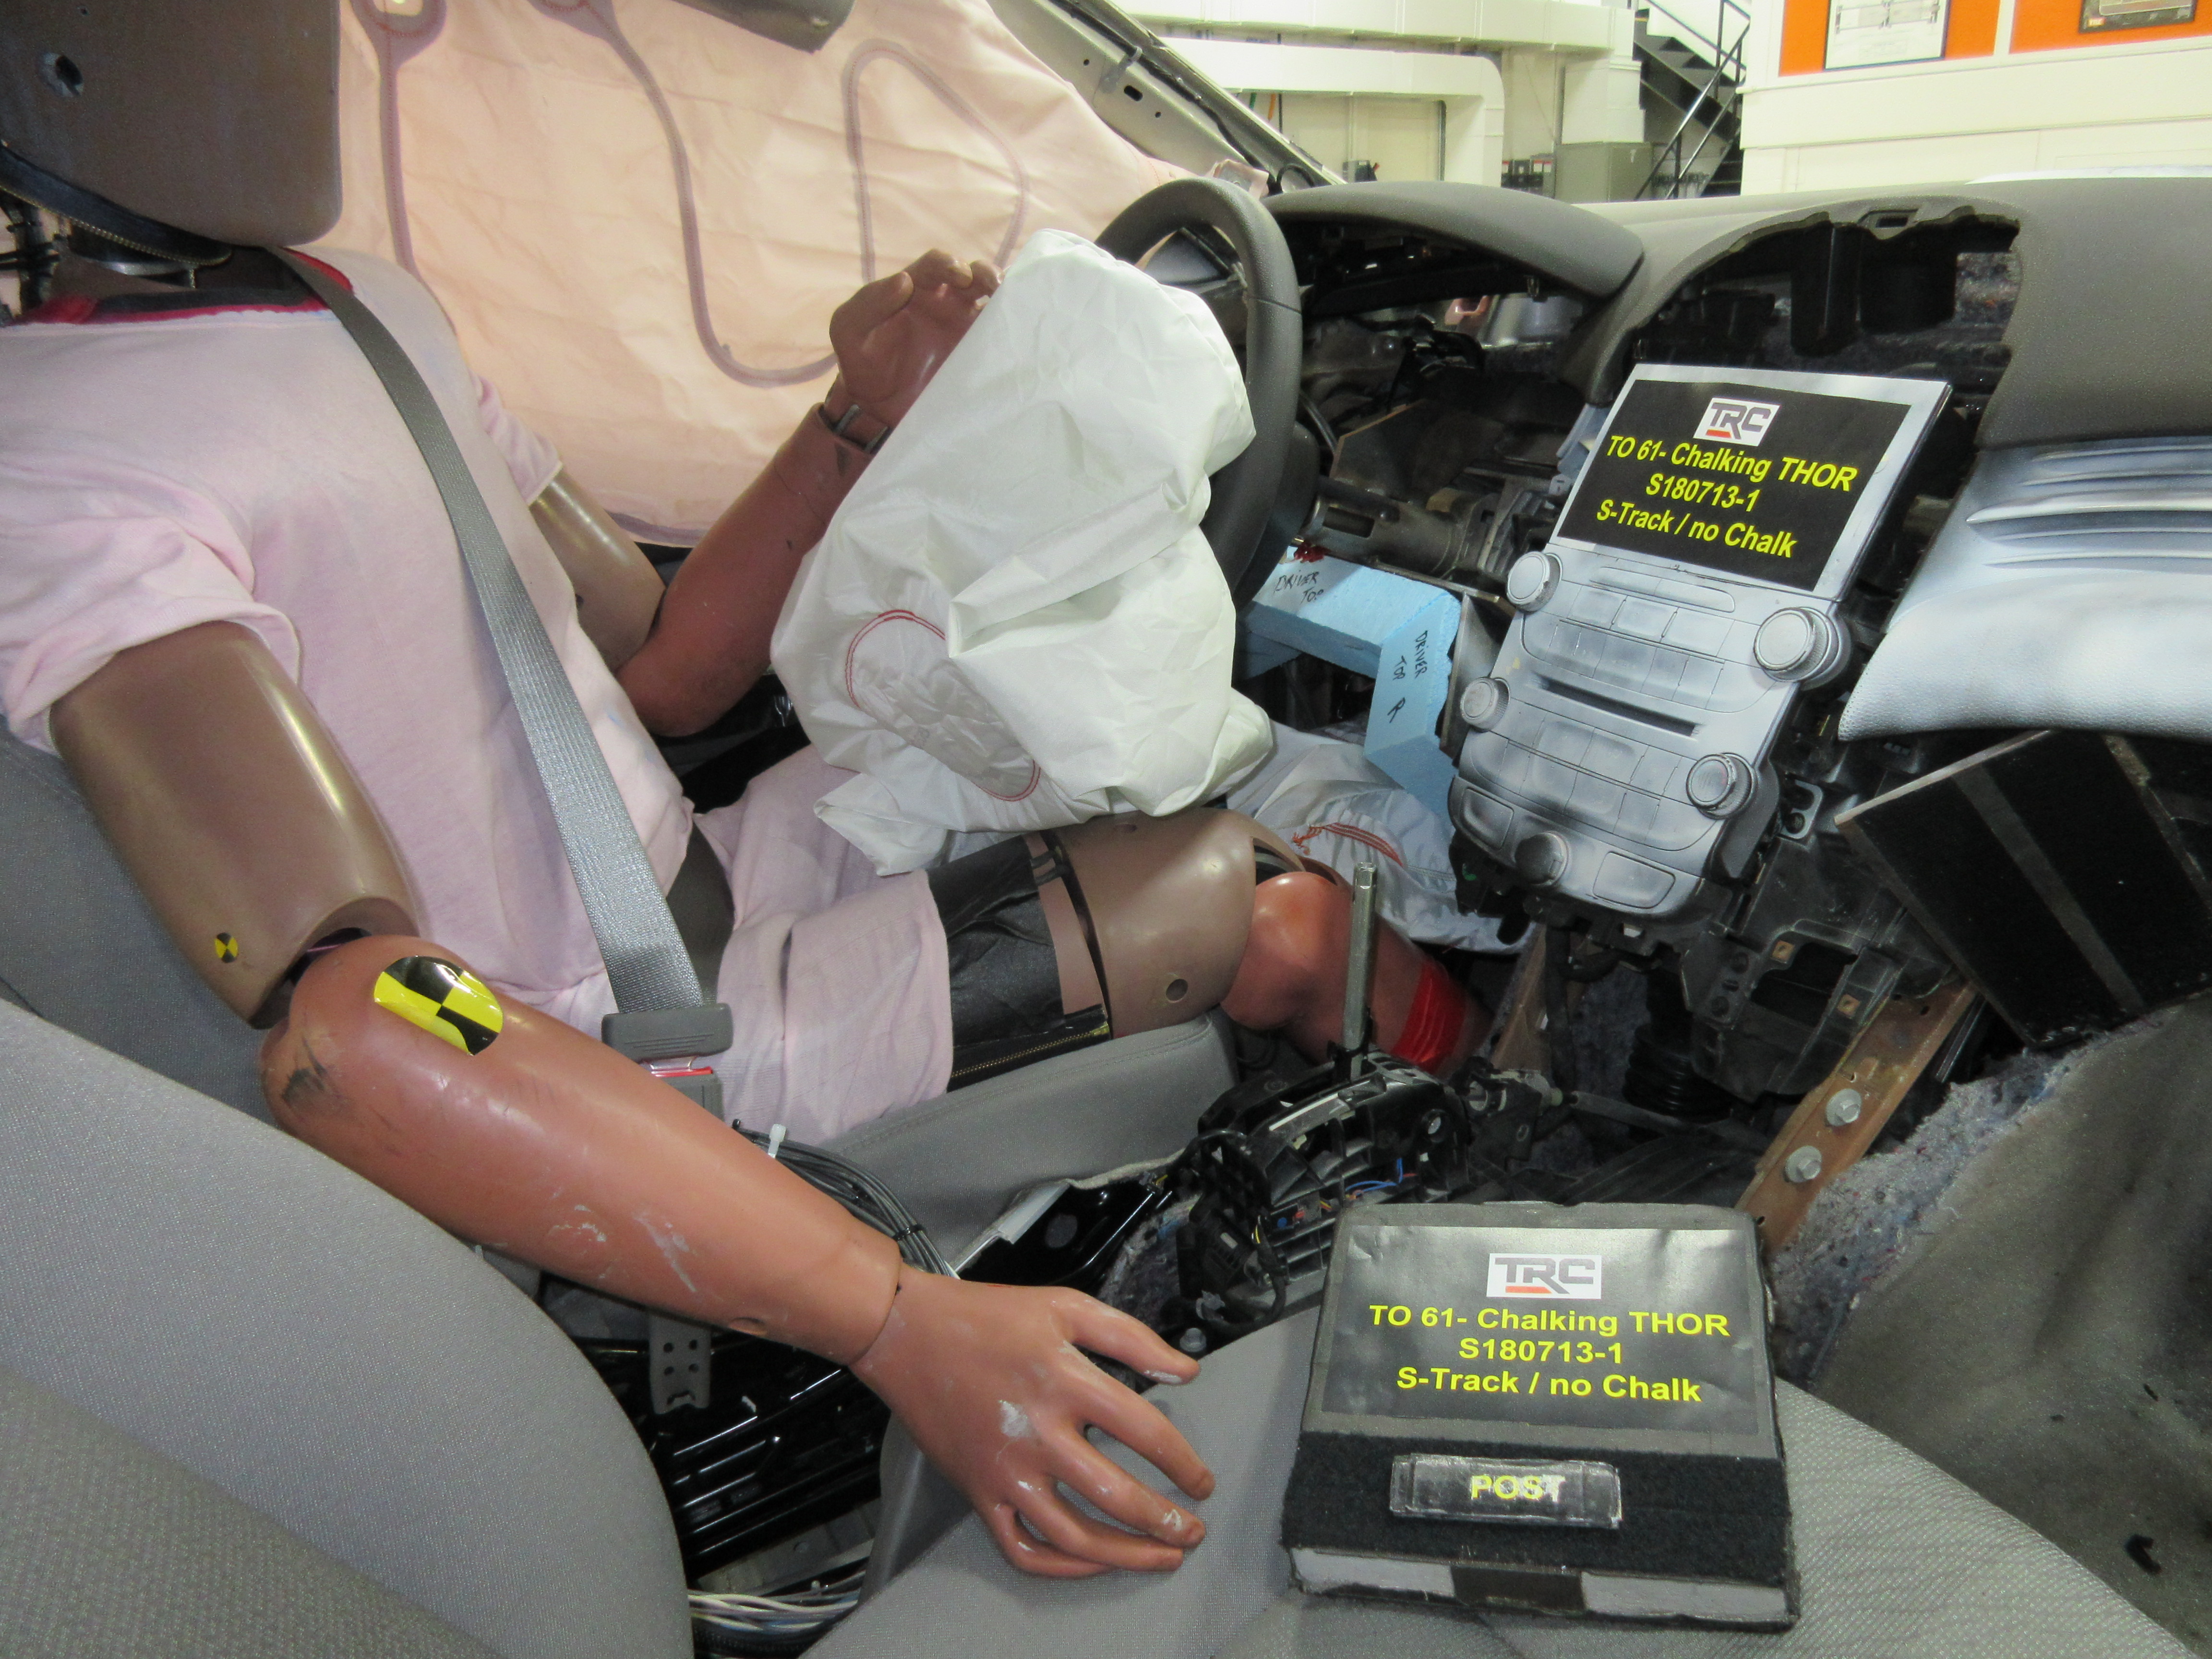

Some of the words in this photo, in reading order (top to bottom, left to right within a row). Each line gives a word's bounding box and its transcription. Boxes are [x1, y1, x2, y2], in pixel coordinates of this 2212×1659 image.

[1710, 402, 1771, 440] TRC
[1606, 435, 1635, 458] TO
[1637, 439, 1667, 461] 61-
[1671, 442, 1772, 483] Chalking
[1778, 456, 1858, 492] THOR
[1646, 472, 1760, 512] S180713-1
[1596, 499, 1675, 533] S-Track
[1674, 513, 1691, 535] /
[1688, 521, 1719, 541] no
[1724, 522, 1797, 558] Chalk
[1495, 1258, 1595, 1294] TRC
[1369, 1304, 1412, 1327] TO
[1421, 1306, 1468, 1328] 61-
[1477, 1308, 1619, 1338] Chalking
[1628, 1310, 1731, 1337] THOR
[1458, 1337, 1623, 1365] S180713-1
[1396, 1366, 1520, 1394] S-Track
[1528, 1371, 1541, 1395] /
[1550, 1378, 1593, 1397] no
[1602, 1373, 1702, 1403] Chalk
[1470, 1474, 1566, 1503] POST
